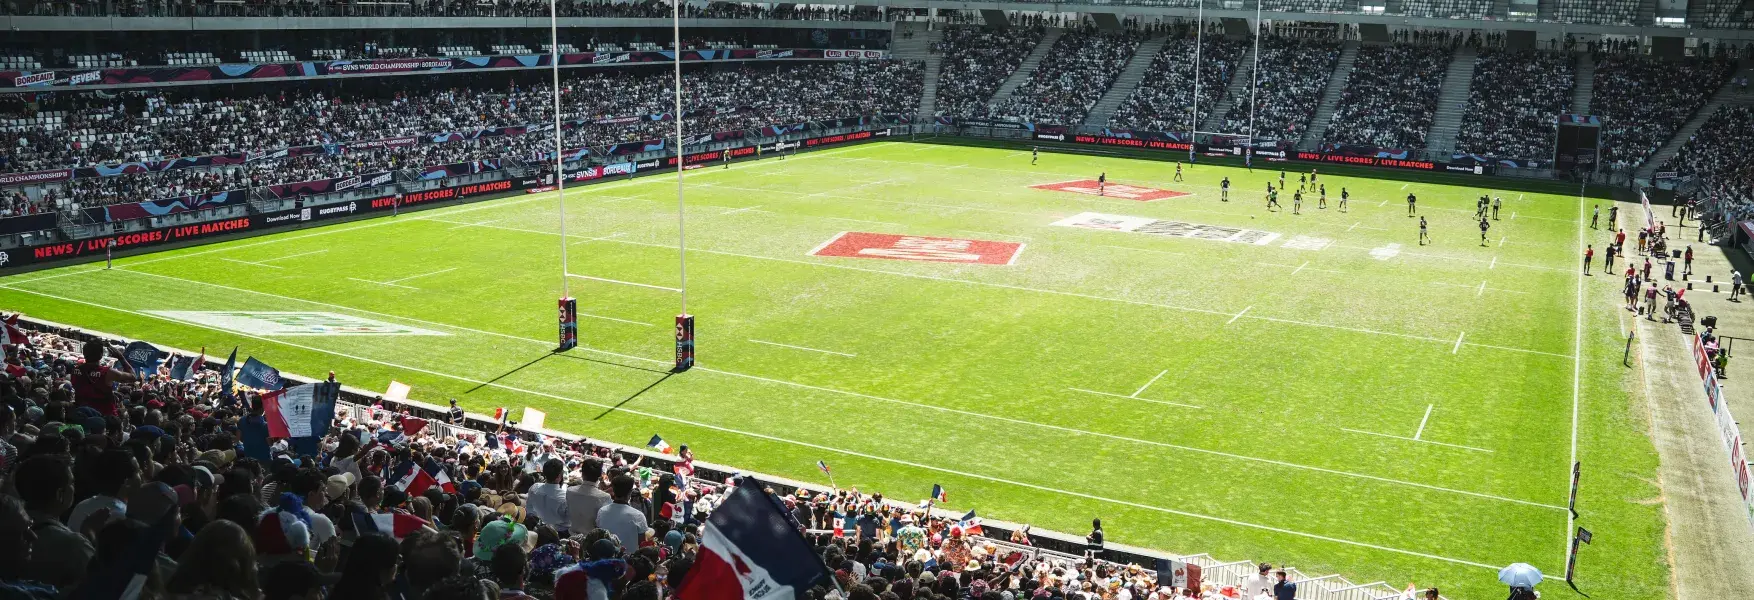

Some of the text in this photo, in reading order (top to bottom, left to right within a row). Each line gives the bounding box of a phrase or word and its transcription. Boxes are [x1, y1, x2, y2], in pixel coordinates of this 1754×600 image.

[17, 73, 54, 85] BORDEAUX
[71, 71, 100, 84] SEVENS
[1166, 142, 1191, 150] MATCH
[1345, 156, 1372, 164] SCORES
[1399, 160, 1434, 169] MATCHES
[15, 172, 62, 181] CHAMPIONSHIP
[371, 172, 392, 186] SEVENS
[372, 197, 396, 208] NEWS
[405, 193, 423, 203] LIVE
[424, 188, 453, 199] SCORES
[461, 186, 477, 195] LIVE
[479, 181, 512, 192] MATCHES
[319, 205, 348, 215] RUGBYPASS
[266, 212, 300, 223] Download Now
[34, 243, 74, 258] NEWS
[76, 241, 84, 255] /
[117, 231, 162, 246] SCORES
[164, 228, 172, 241] /
[175, 225, 199, 238] LIVE
[201, 218, 250, 234] MATCHES
